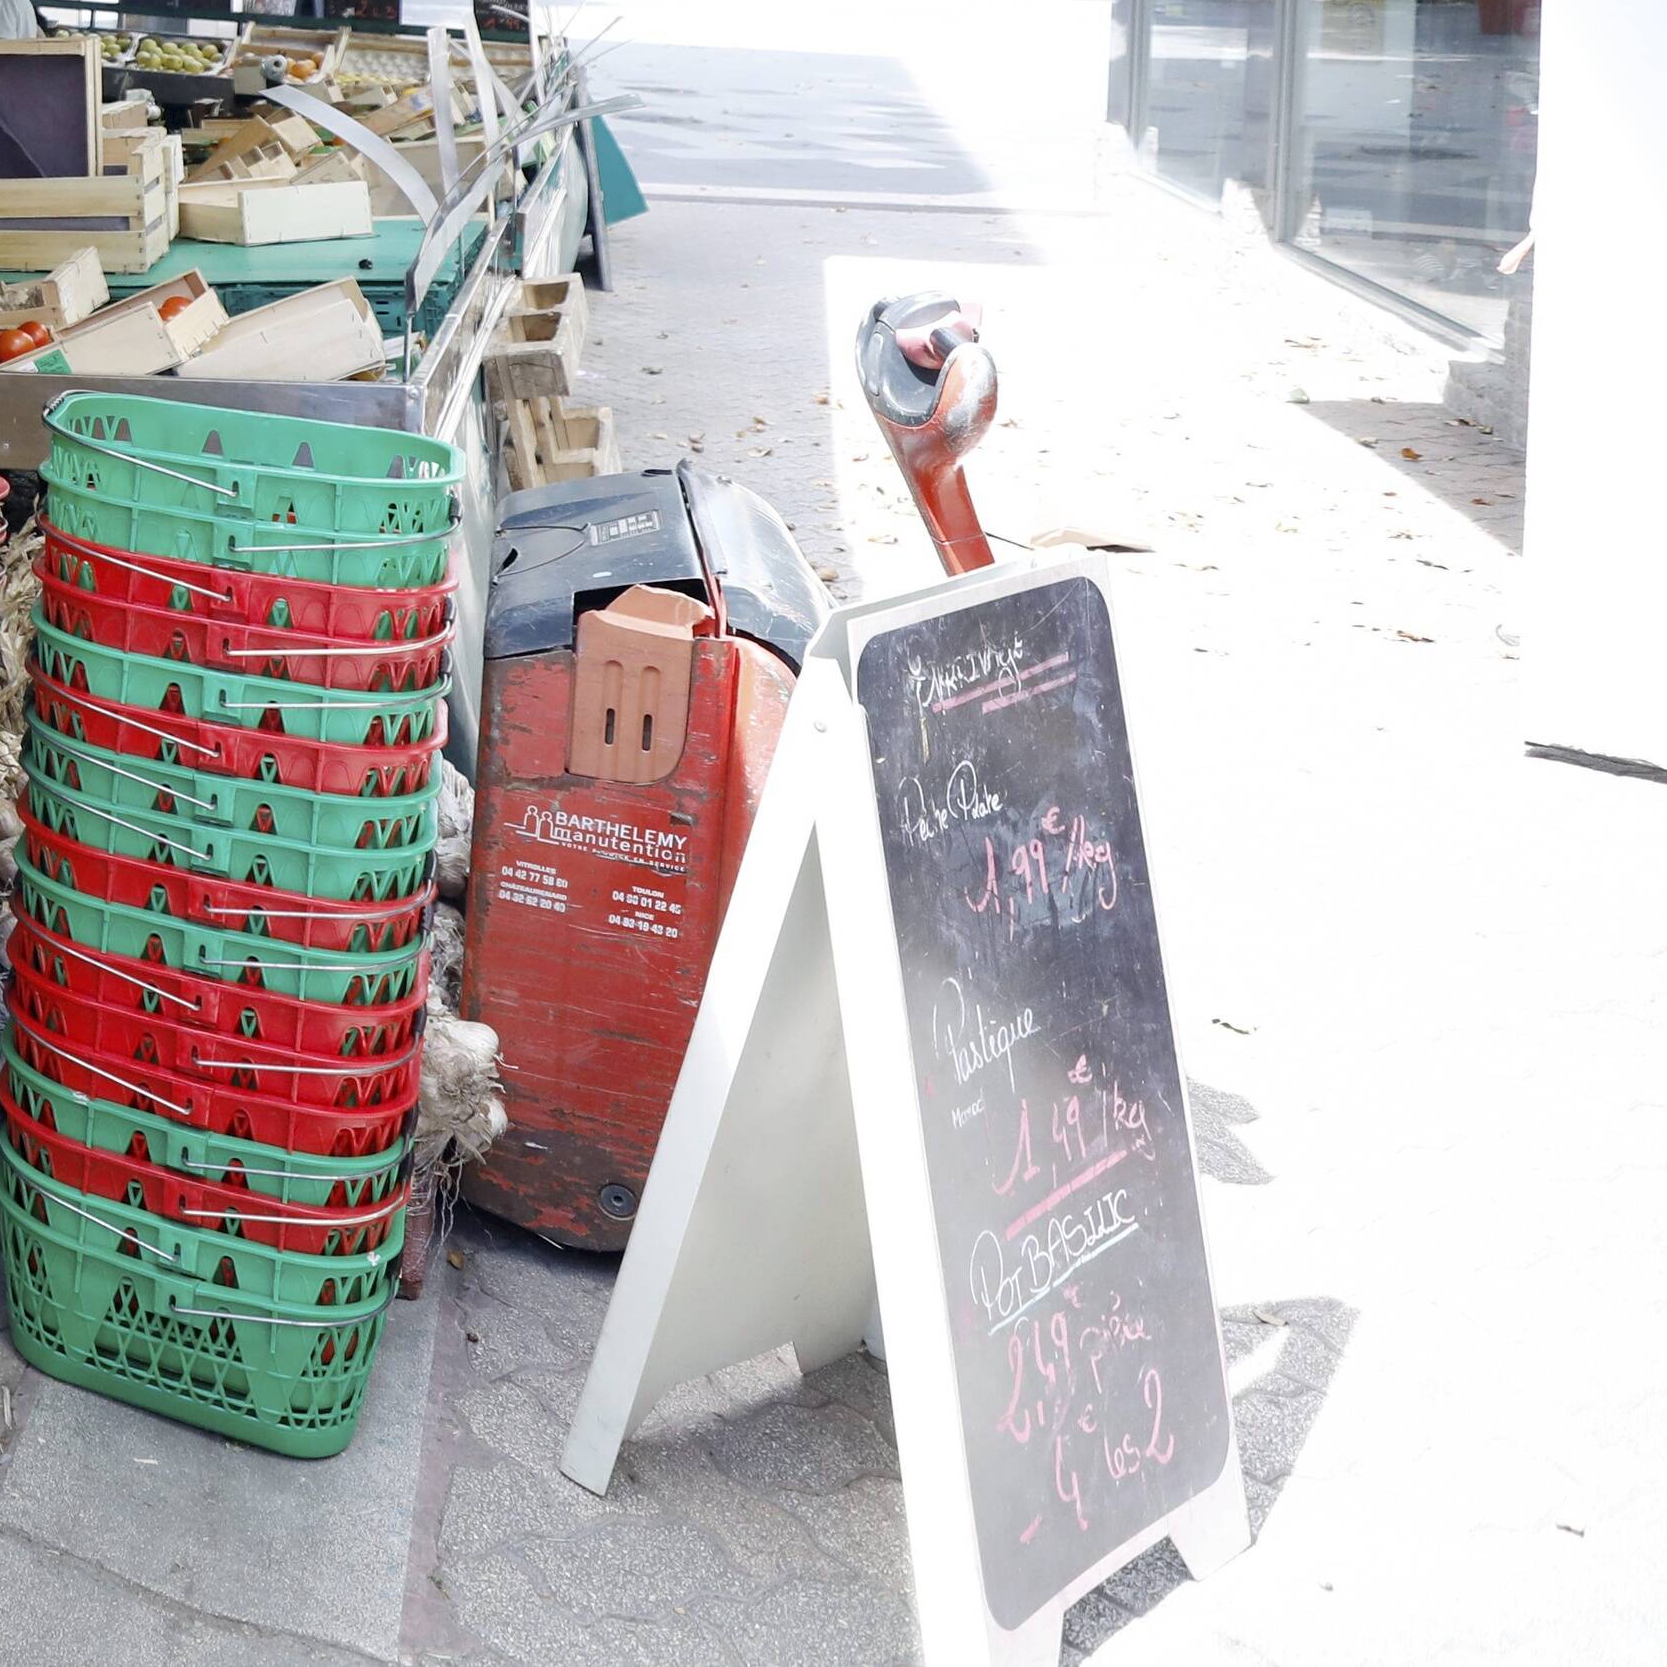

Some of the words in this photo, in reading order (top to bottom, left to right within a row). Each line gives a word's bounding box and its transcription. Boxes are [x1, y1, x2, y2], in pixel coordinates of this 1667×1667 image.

[554, 811, 688, 850] BARTHELEMY
[553, 825, 687, 864] manutention
[501, 866, 513, 877] 04
[515, 869, 527, 881] 42
[529, 872, 541, 883] 77
[516, 860, 557, 874] VITROLLES
[649, 860, 685, 872] SERVICE
[498, 889, 511, 901] 04
[612, 890, 625, 902] 04
[640, 897, 653, 909] 01
[654, 900, 668, 912] 22
[631, 885, 665, 899] TOULON
[634, 911, 655, 922] NICE
[608, 914, 621, 926] 04
[665, 927, 679, 939] 20
[1022, 1189, 1136, 1294] BASILIC
[1143, 1367, 1175, 1465] 2
